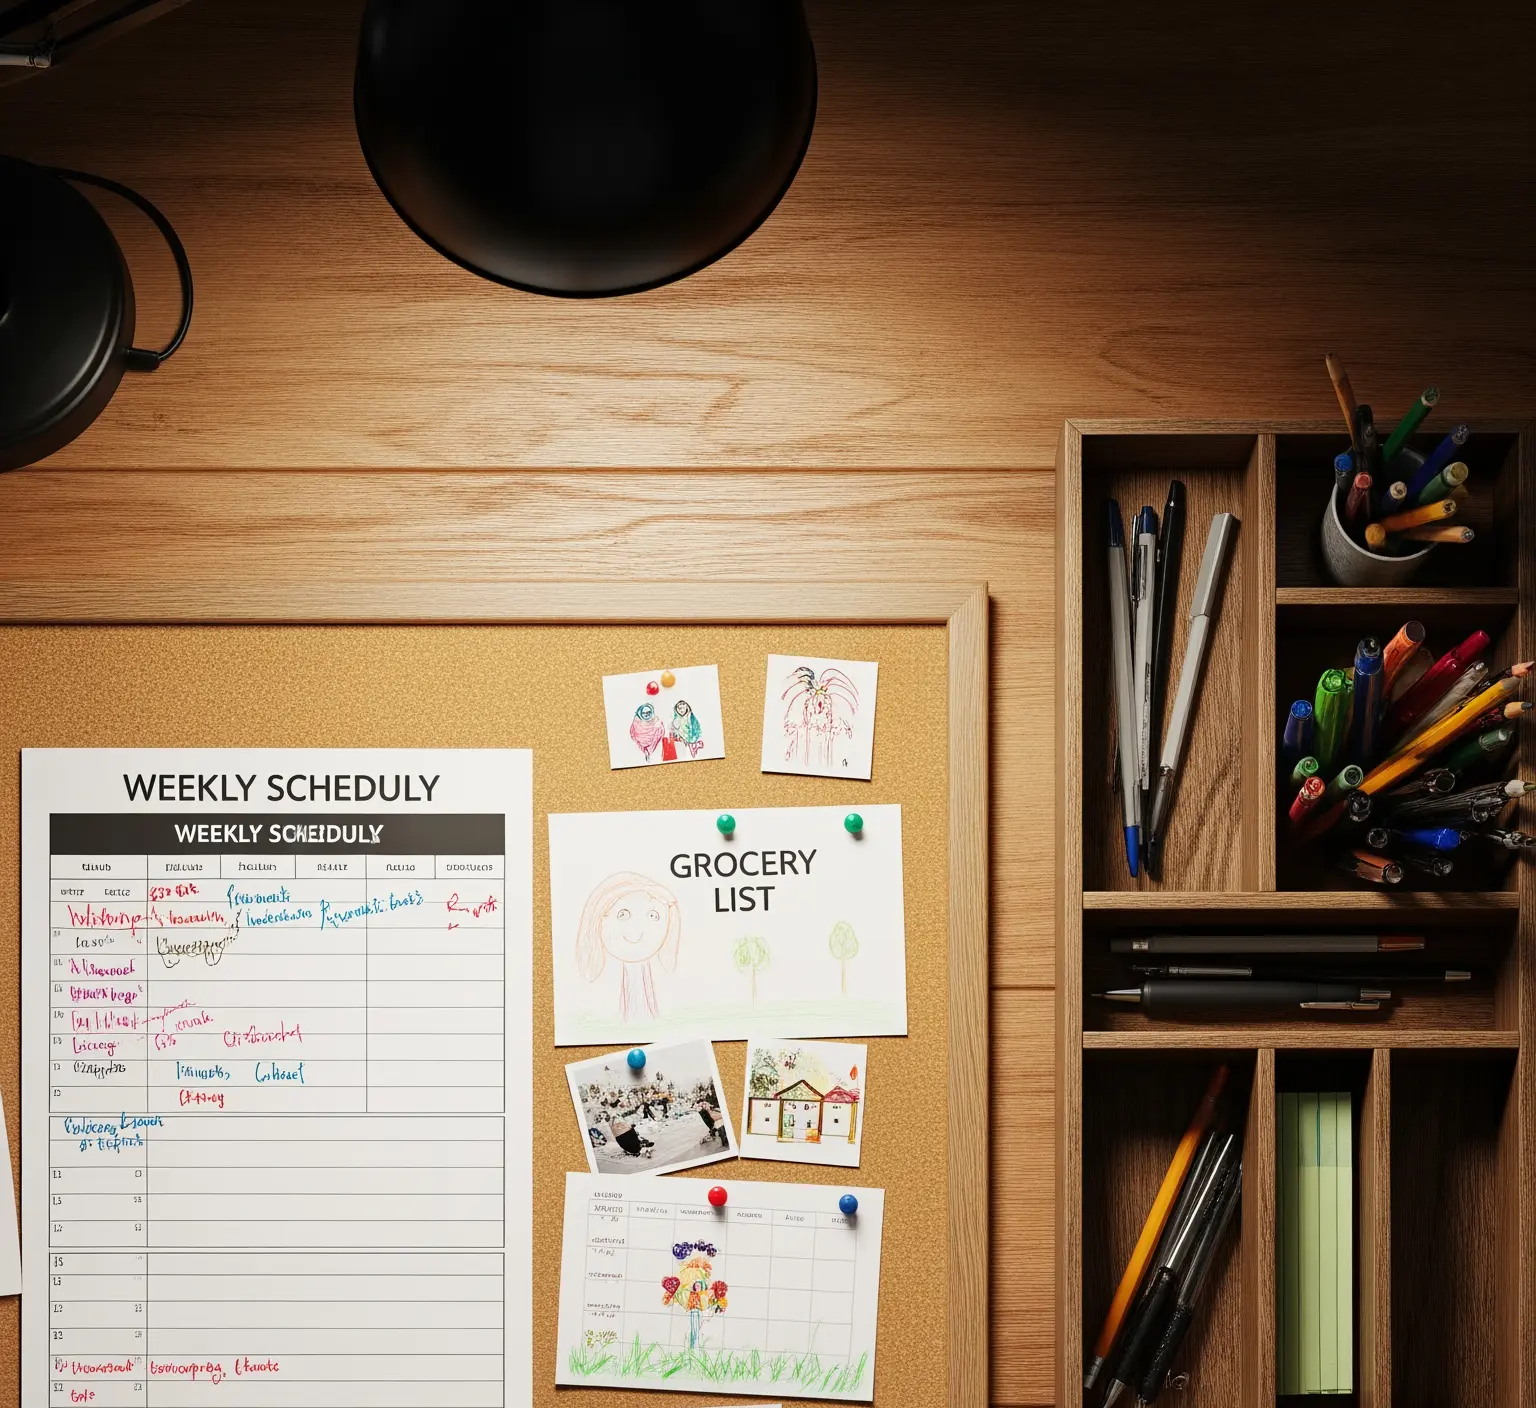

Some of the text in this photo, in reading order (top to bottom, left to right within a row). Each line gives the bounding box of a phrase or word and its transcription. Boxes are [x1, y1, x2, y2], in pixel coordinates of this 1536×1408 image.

[122, 773, 440, 802] WEEKLY SCHEDULY
[174, 824, 264, 844] WEEKLY
[669, 848, 818, 879] GROCERY
[714, 885, 776, 913] LIST
